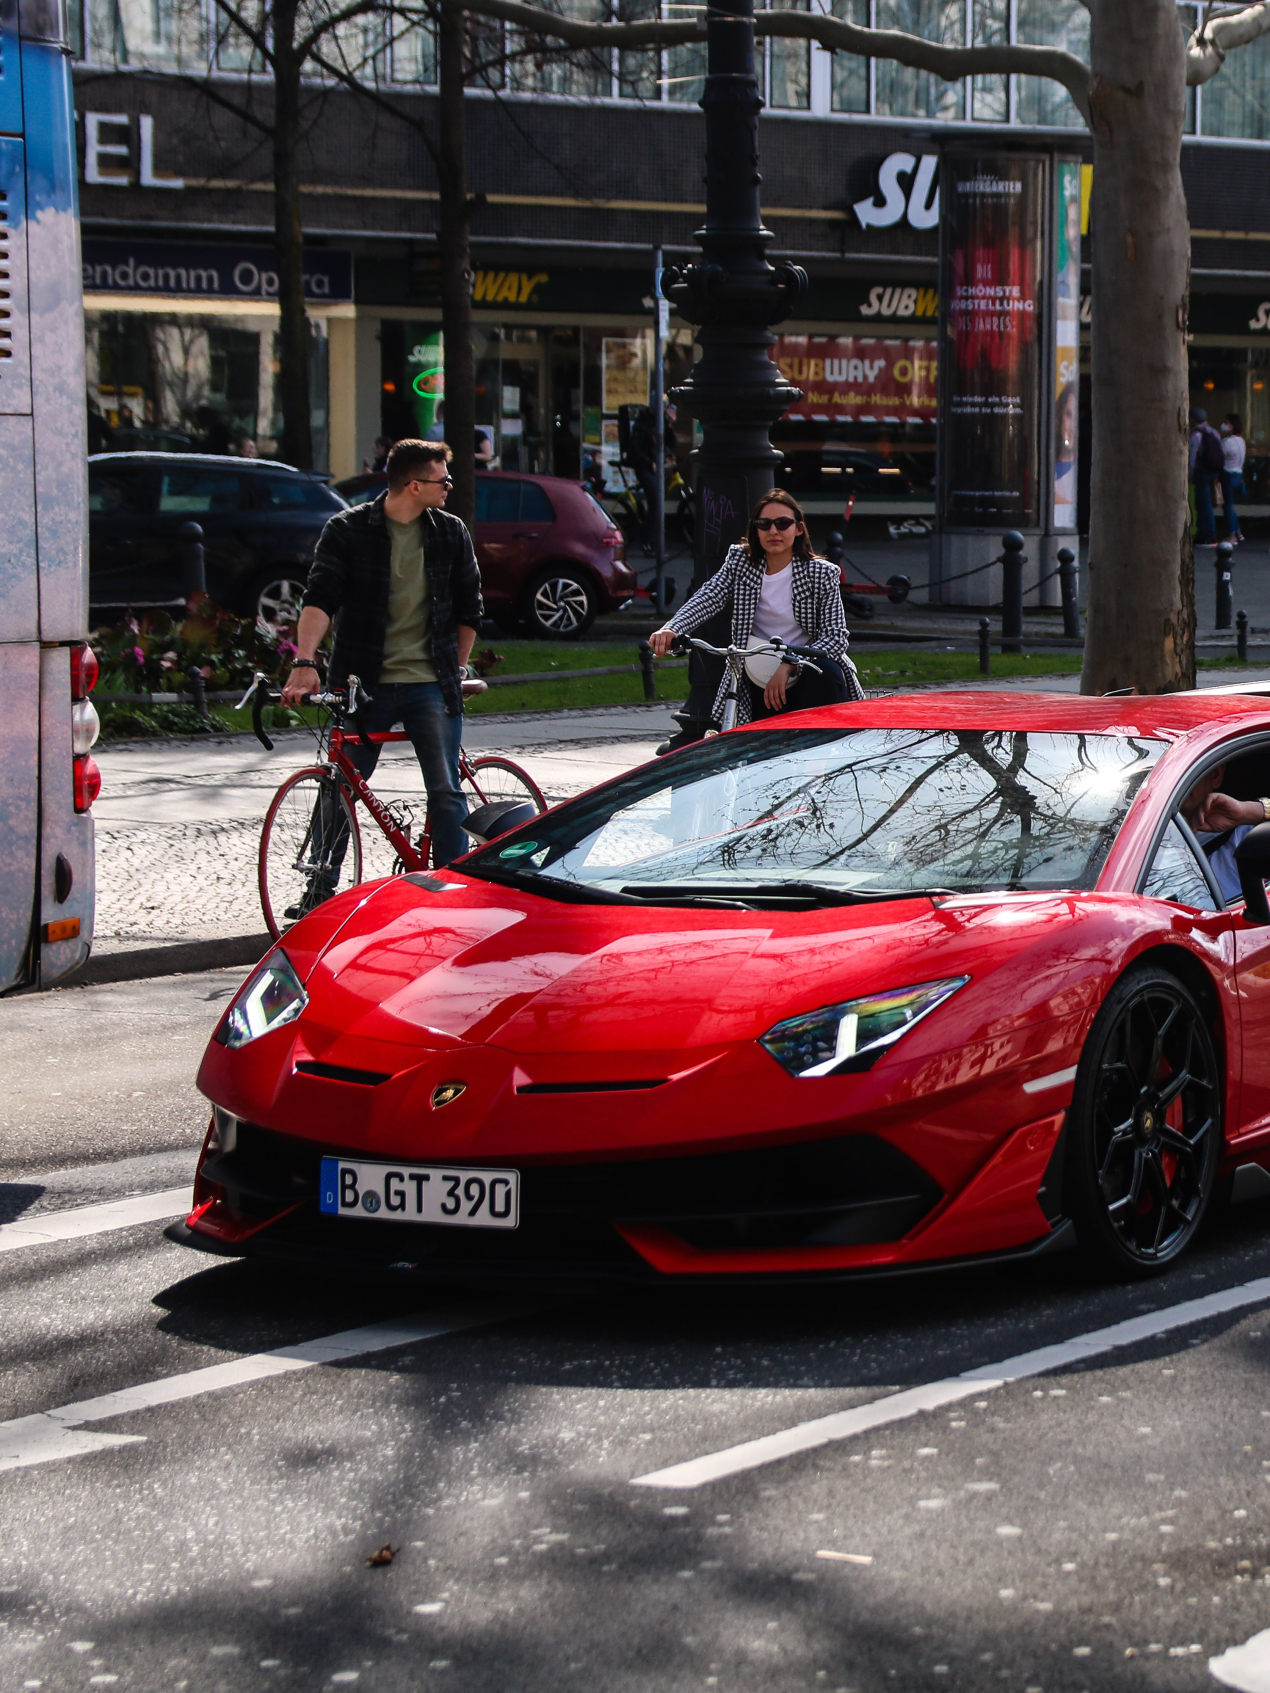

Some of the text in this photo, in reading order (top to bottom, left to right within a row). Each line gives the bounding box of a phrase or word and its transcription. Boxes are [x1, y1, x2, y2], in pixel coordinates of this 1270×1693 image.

[74, 110, 184, 189] EL
[233, 261, 331, 298] Opra
[464, 268, 549, 303] WAY
[976, 263, 992, 279] DIE
[859, 286, 939, 317] SUBW
[956, 283, 1021, 297] SCHÖNSTE
[778, 356, 886, 383] SUBWAY
[808, 391, 829, 404] Nur
[359, 779, 397, 833] CANYON
[326, 1192, 334, 1203] D
[340, 1167, 512, 1219] B GT 390
